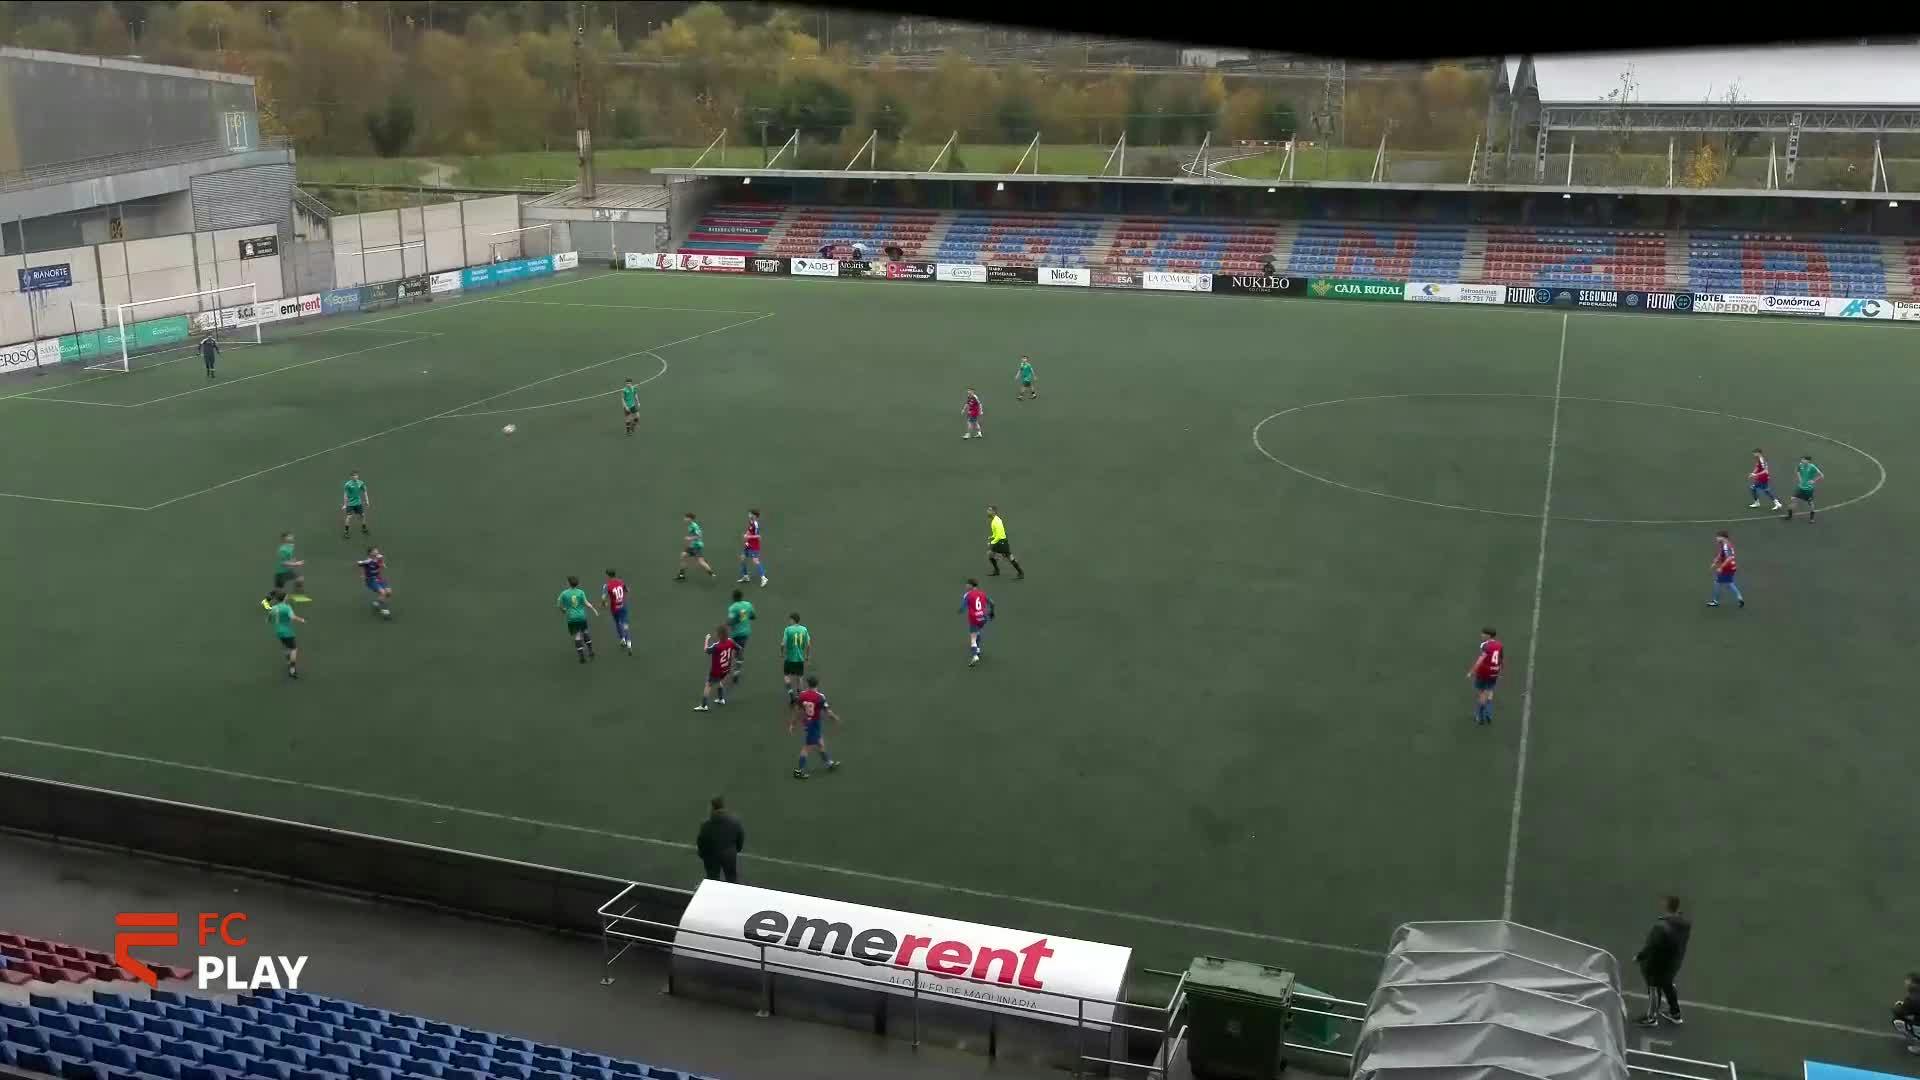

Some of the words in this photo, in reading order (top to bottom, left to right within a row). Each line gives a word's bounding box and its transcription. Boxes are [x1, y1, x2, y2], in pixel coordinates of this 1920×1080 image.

[1051, 269, 1078, 281] Nietos
[1232, 275, 1290, 289] NUKLEO
[1335, 284, 1362, 294] CAJA
[1364, 285, 1402, 295] RURAL
[1507, 287, 1535, 304] FUTUR
[1579, 289, 1618, 303] SEGUNDA
[1646, 293, 1675, 310] FUTUR
[1694, 293, 1726, 303] HOTEL
[1897, 301, 1920, 309] Desc
[612, 586, 625, 600] 10
[975, 596, 982, 610] 6
[719, 648, 732, 664] 21
[1491, 649, 1500, 665] 4
[743, 909, 1054, 990] emerent
